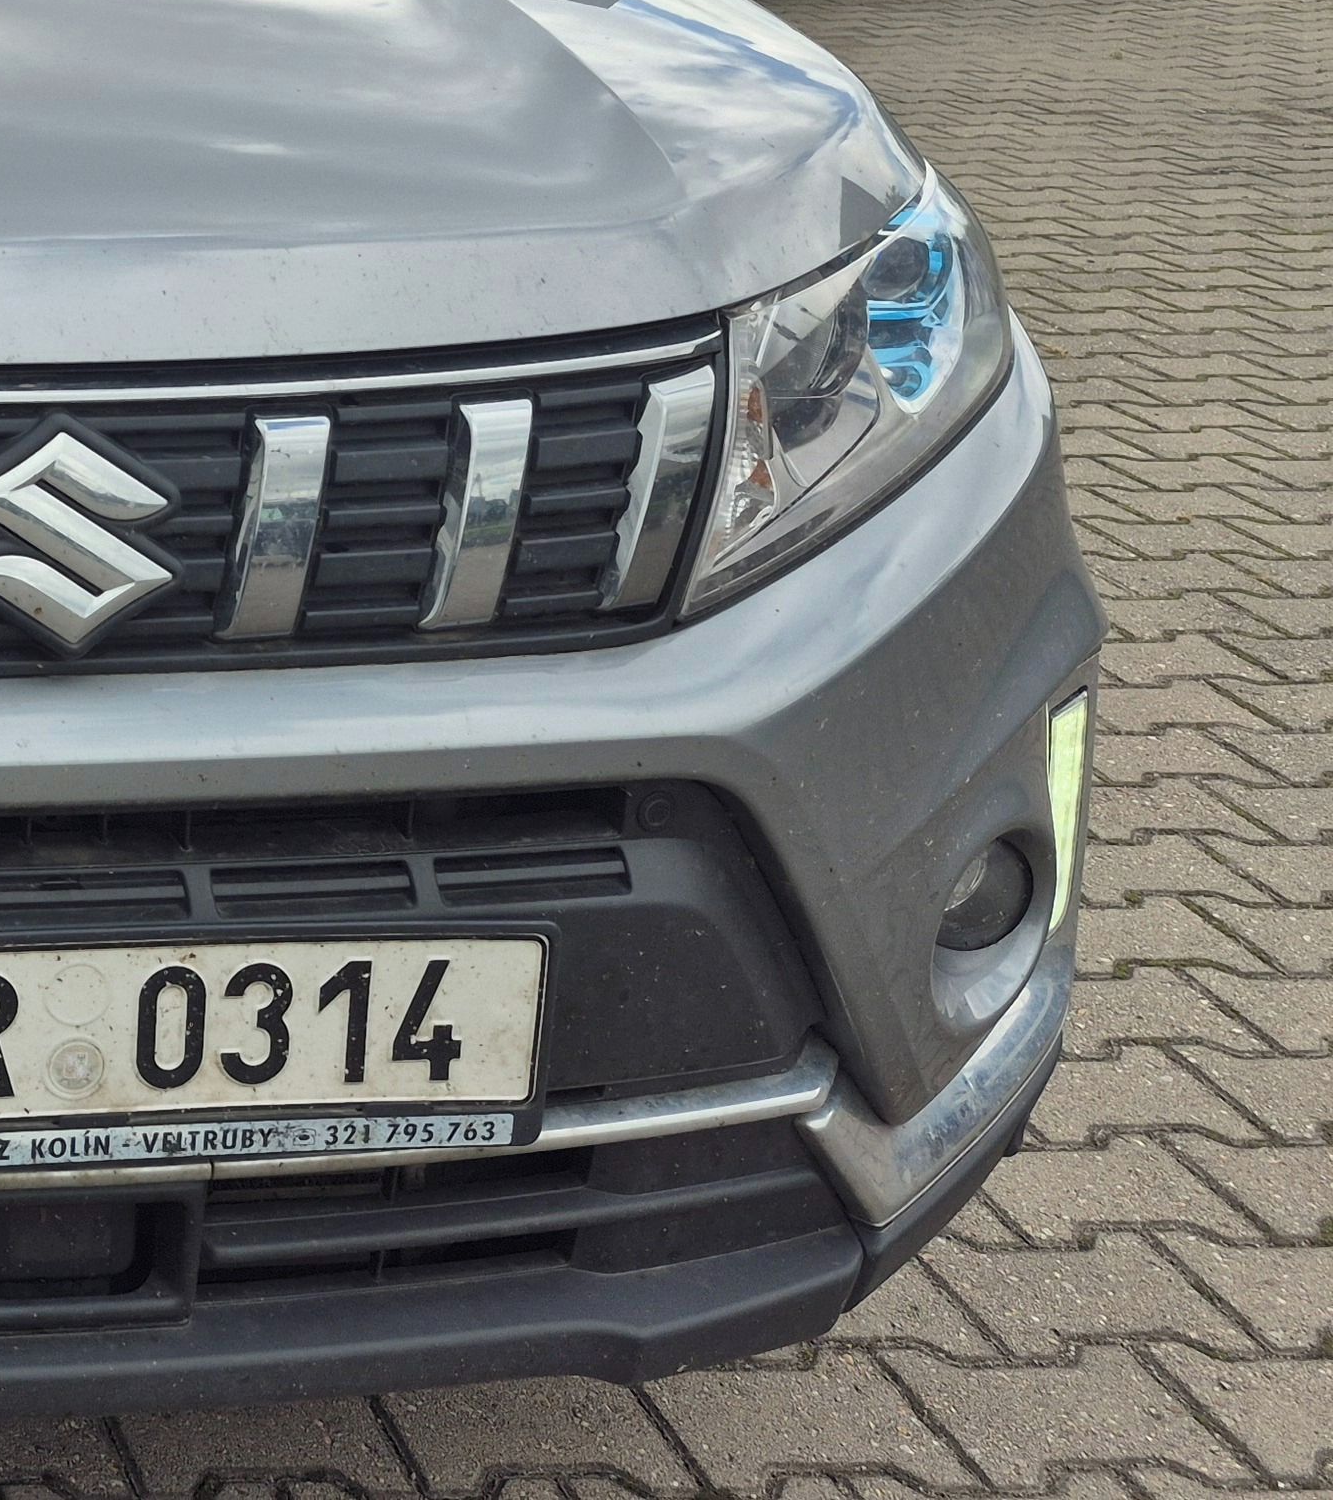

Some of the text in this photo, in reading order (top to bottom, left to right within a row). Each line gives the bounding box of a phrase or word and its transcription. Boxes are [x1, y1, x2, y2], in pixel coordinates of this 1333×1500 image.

[136, 959, 462, 1090] 0314
[31, 1131, 111, 1160] KOLÍN
[141, 1126, 276, 1154] VELTRUBY
[324, 1124, 371, 1147] 321
[386, 1121, 435, 1145] 795
[446, 1120, 497, 1142] 763
